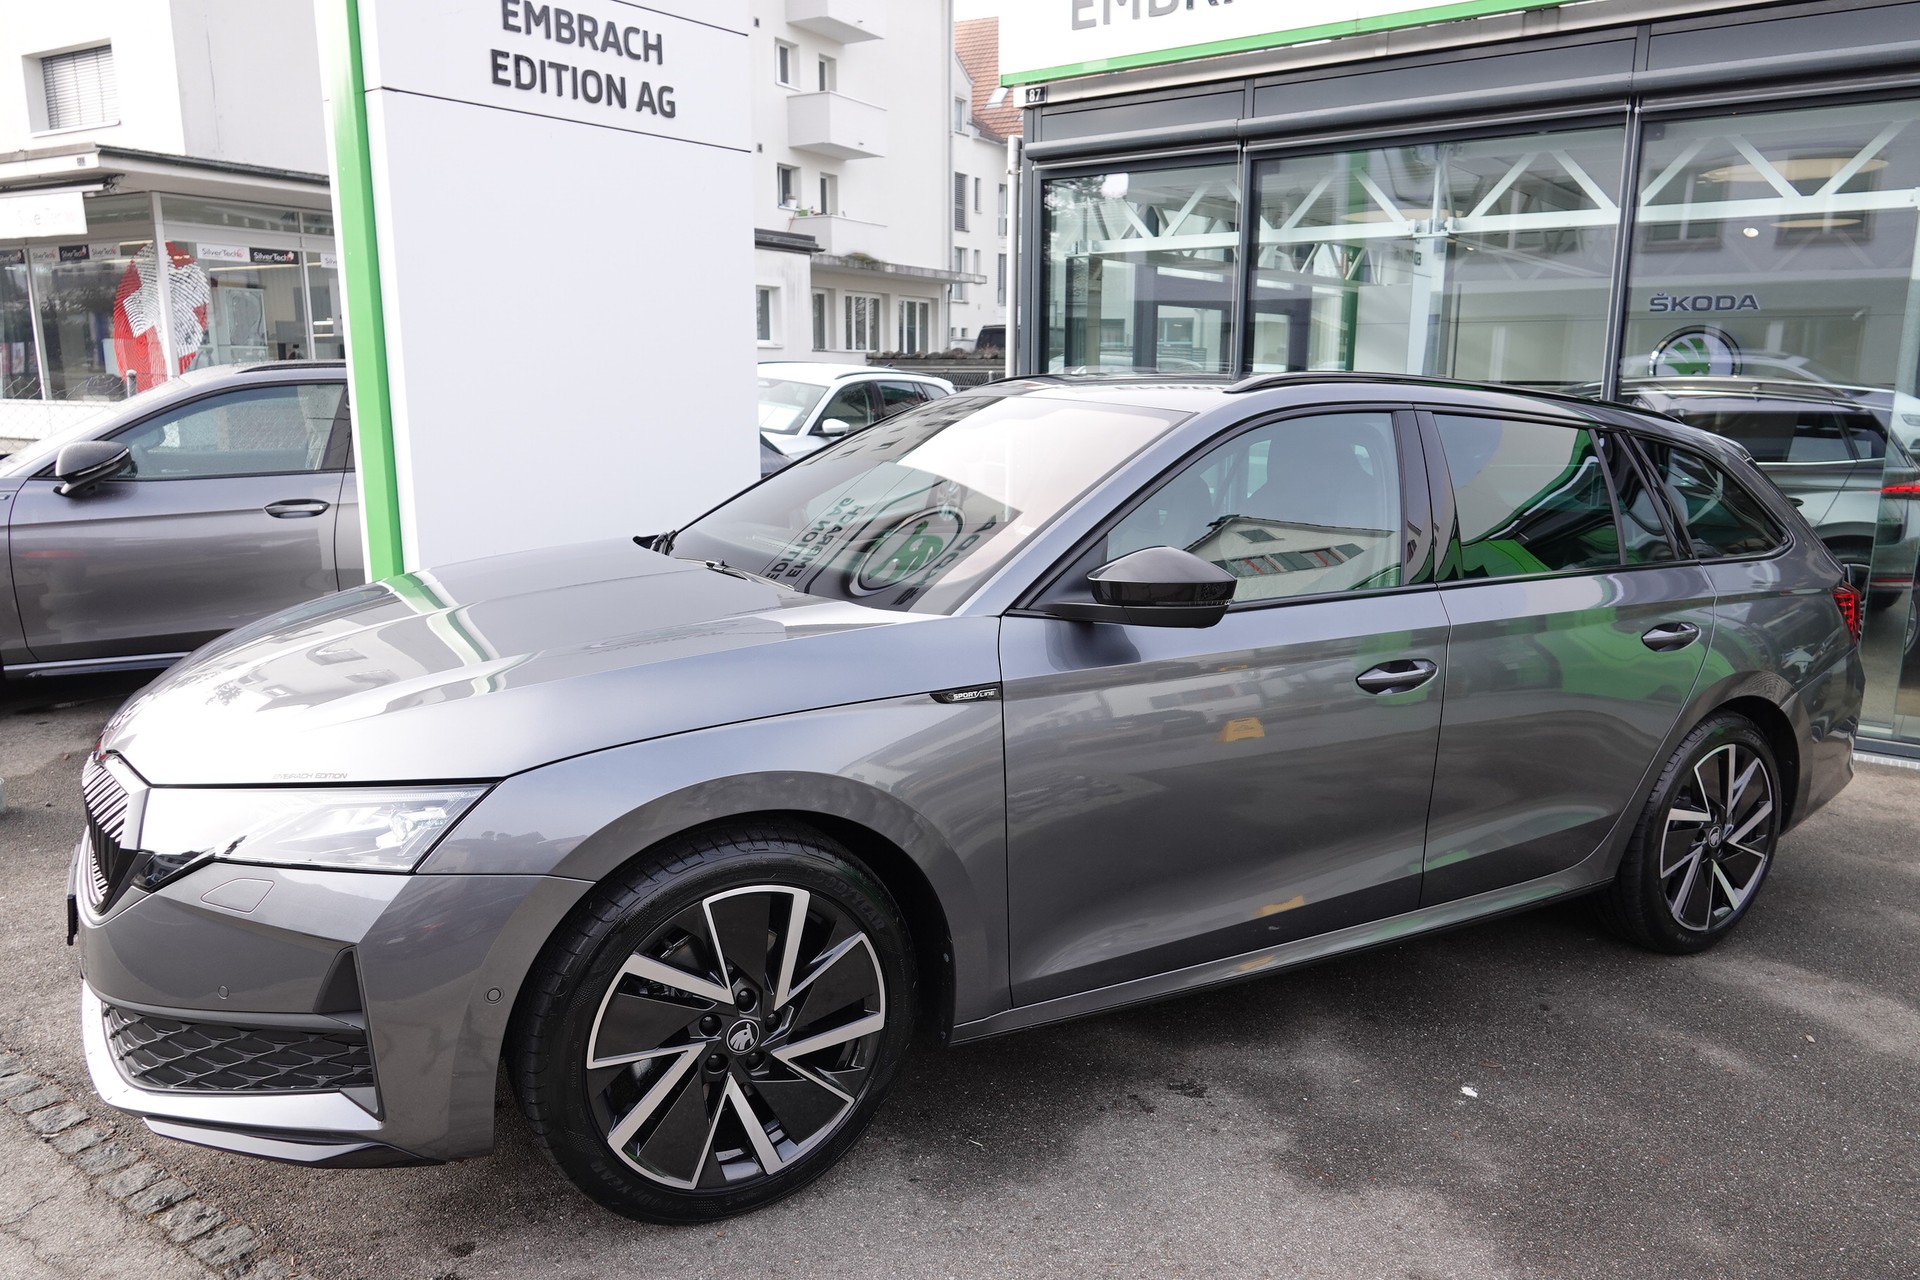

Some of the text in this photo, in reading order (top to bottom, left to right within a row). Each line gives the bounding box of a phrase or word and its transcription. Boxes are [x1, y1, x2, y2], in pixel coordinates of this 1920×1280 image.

[501, 0, 663, 65] EMBRACH
[490, 48, 676, 119] EDITION AG
[1028, 88, 1042, 102] 87
[1649, 292, 1759, 312] ŠKODA
[315, 772, 348, 780] EDITION
